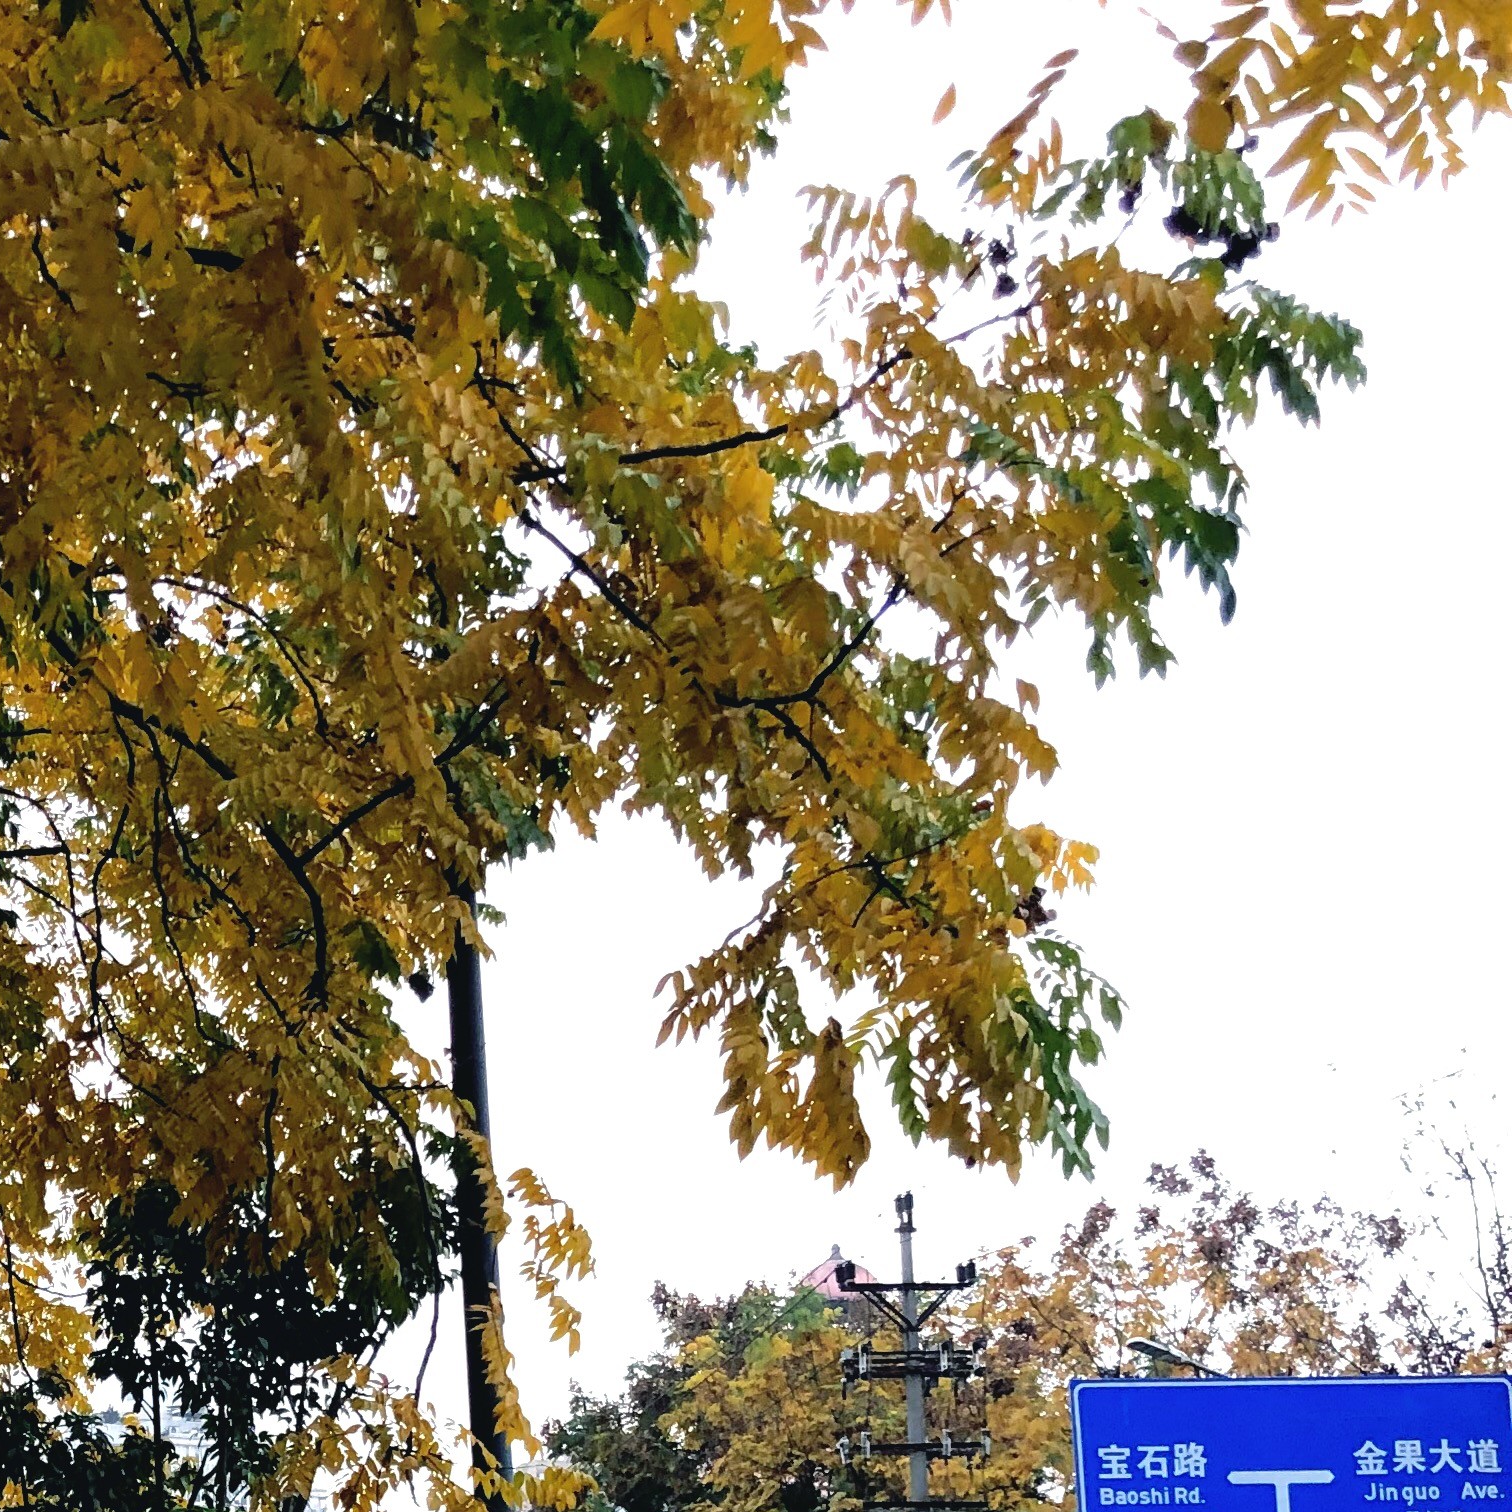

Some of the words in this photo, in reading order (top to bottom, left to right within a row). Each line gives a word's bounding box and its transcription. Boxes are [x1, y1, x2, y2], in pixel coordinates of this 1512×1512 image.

[1098, 1441, 1207, 1479] 宝石路
[1353, 1439, 1502, 1475] 金果大道
[1100, 1487, 1170, 1505] Baoshi
[1174, 1486, 1206, 1504] Rd.
[1364, 1482, 1440, 1506] Jinguo
[1461, 1481, 1505, 1499] Ave.
